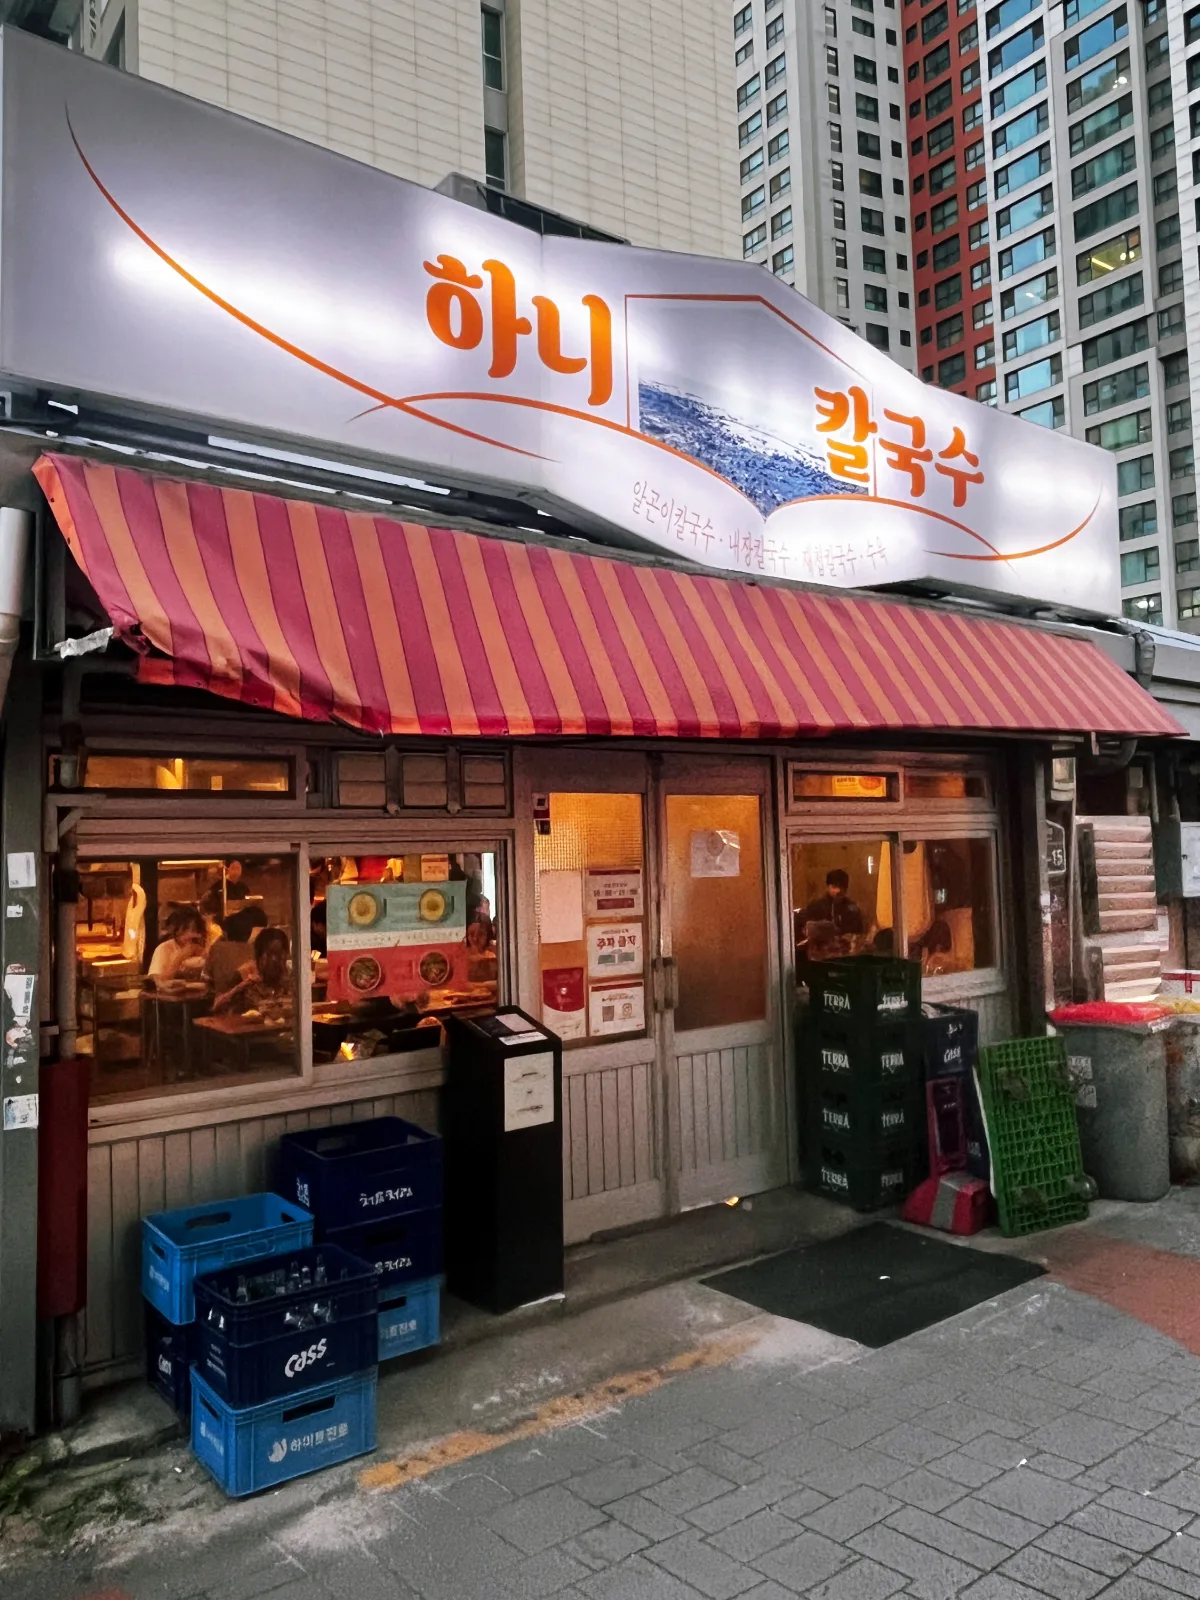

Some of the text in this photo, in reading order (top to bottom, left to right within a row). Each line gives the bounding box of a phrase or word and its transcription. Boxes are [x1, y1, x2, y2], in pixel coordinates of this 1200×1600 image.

[422, 253, 985, 508] 하니 칼국수
[632, 479, 716, 553] 알곤이칼국수
[728, 527, 791, 575] 내장칼국수
[866, 536, 889, 570] 수육
[823, 990, 850, 1010] TERRA
[821, 1050, 850, 1069] TERRA
[881, 1052, 904, 1068] TERRA
[822, 1108, 850, 1129] TERRA
[821, 1166, 849, 1190] TERRA
[290, 1423, 349, 1452] 하이트진로
